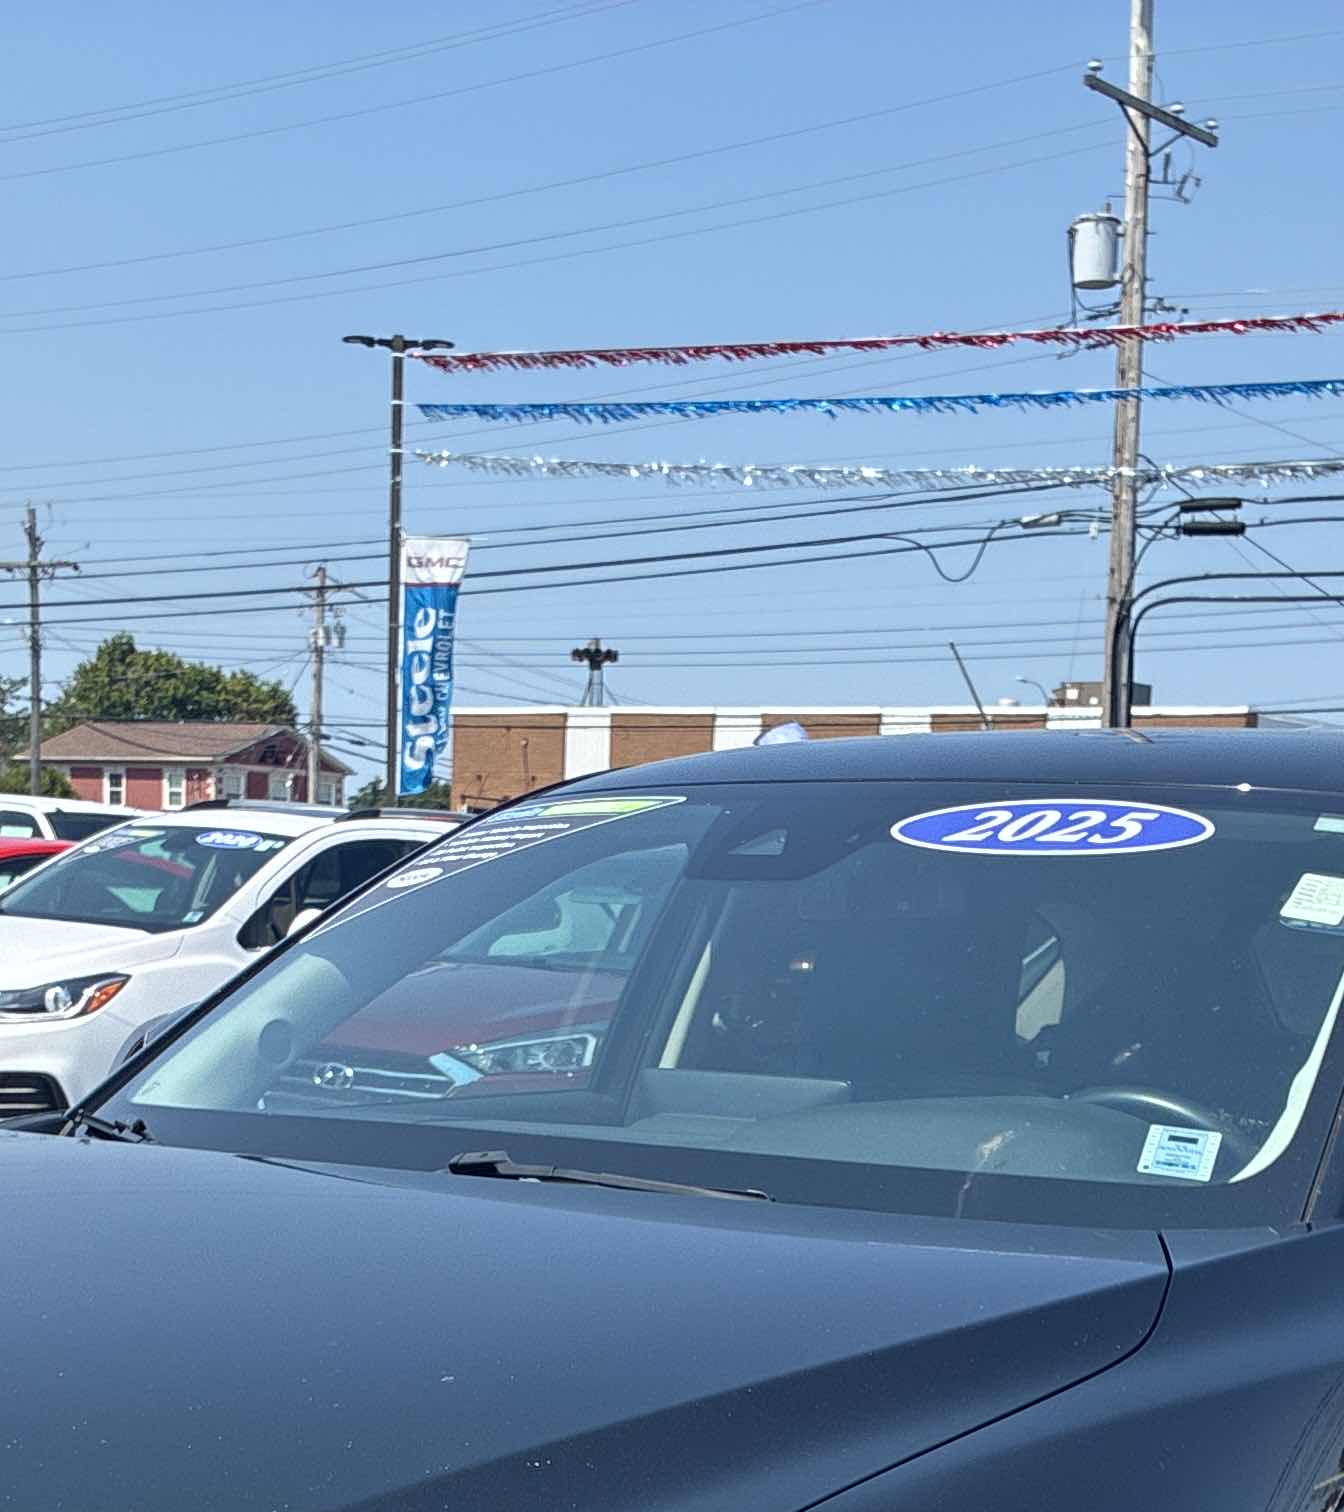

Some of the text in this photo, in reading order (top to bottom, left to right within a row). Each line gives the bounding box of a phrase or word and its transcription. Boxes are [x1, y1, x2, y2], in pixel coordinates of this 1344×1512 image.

[407, 556, 464, 569] GMC
[433, 608, 456, 702] CHEVROLET
[404, 607, 436, 769] Steele
[942, 809, 1160, 845] 2025
